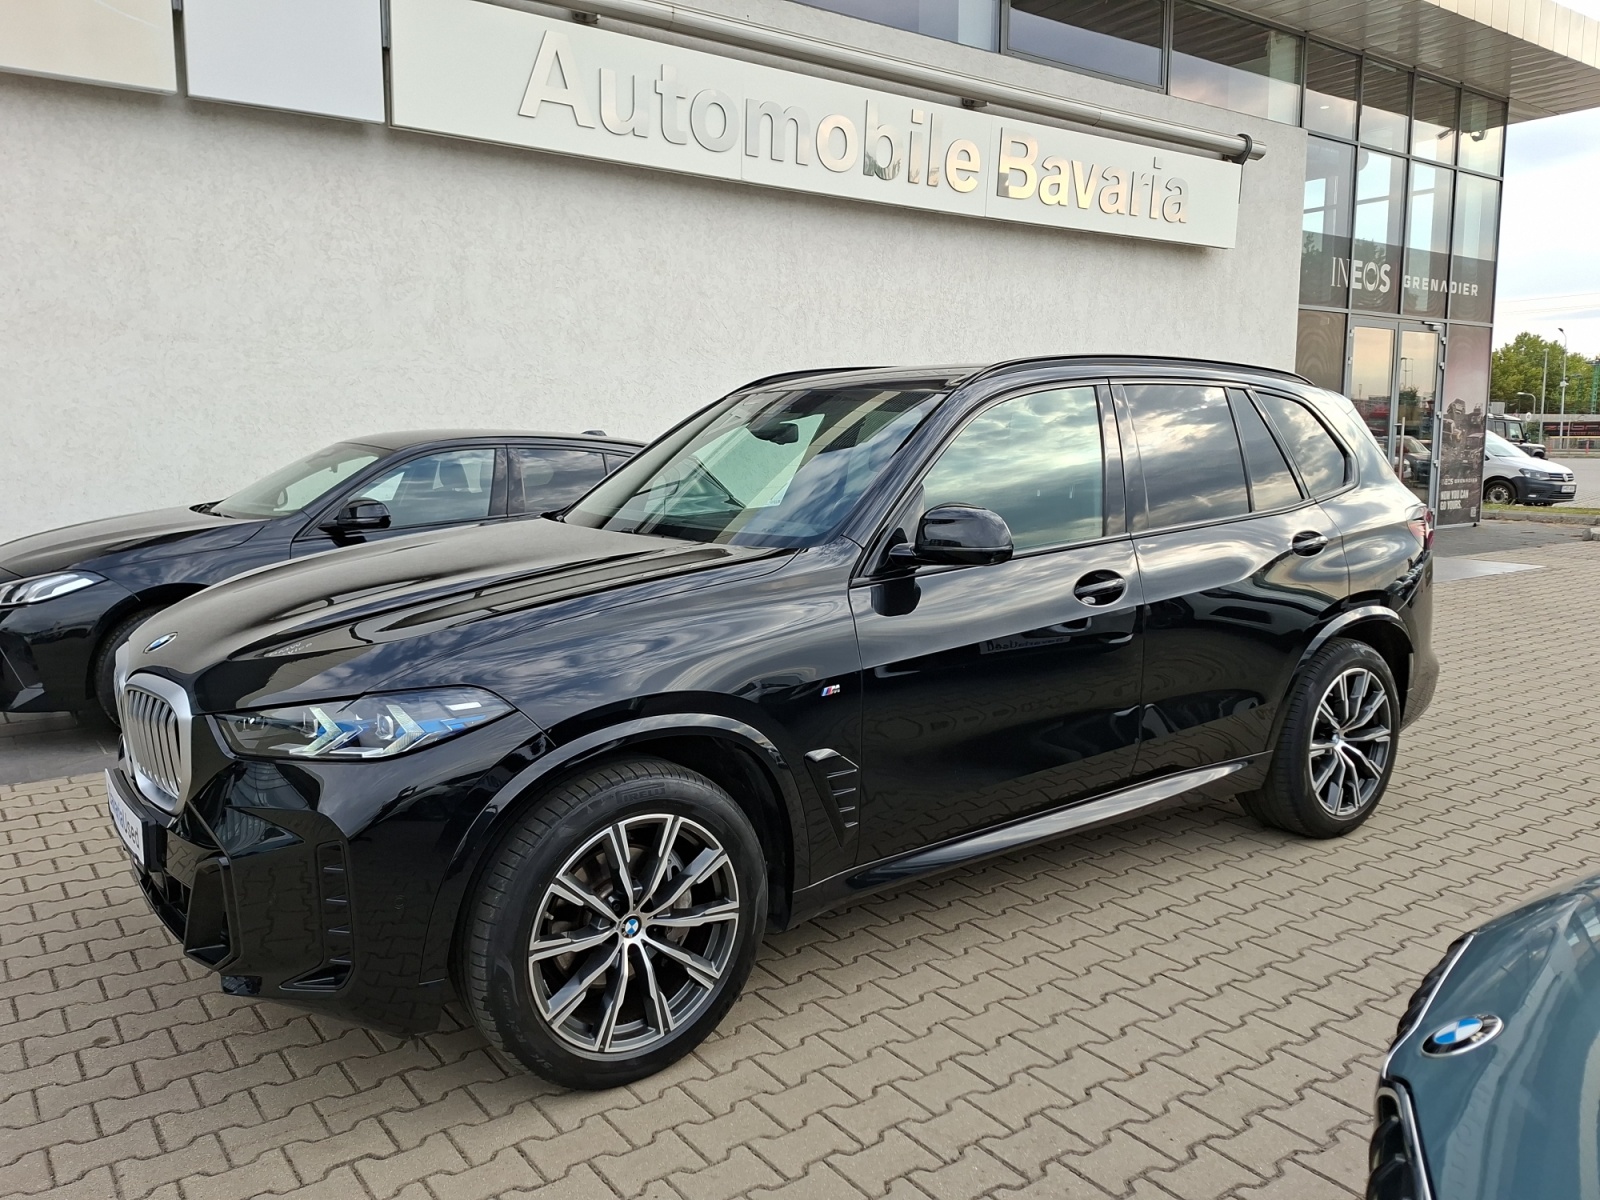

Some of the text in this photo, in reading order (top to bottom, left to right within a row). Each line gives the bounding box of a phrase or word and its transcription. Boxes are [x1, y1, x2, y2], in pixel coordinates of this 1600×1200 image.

[518, 30, 1189, 224] Automobile Bavaria
[1330, 256, 1478, 297] INEOS GRENADIER
